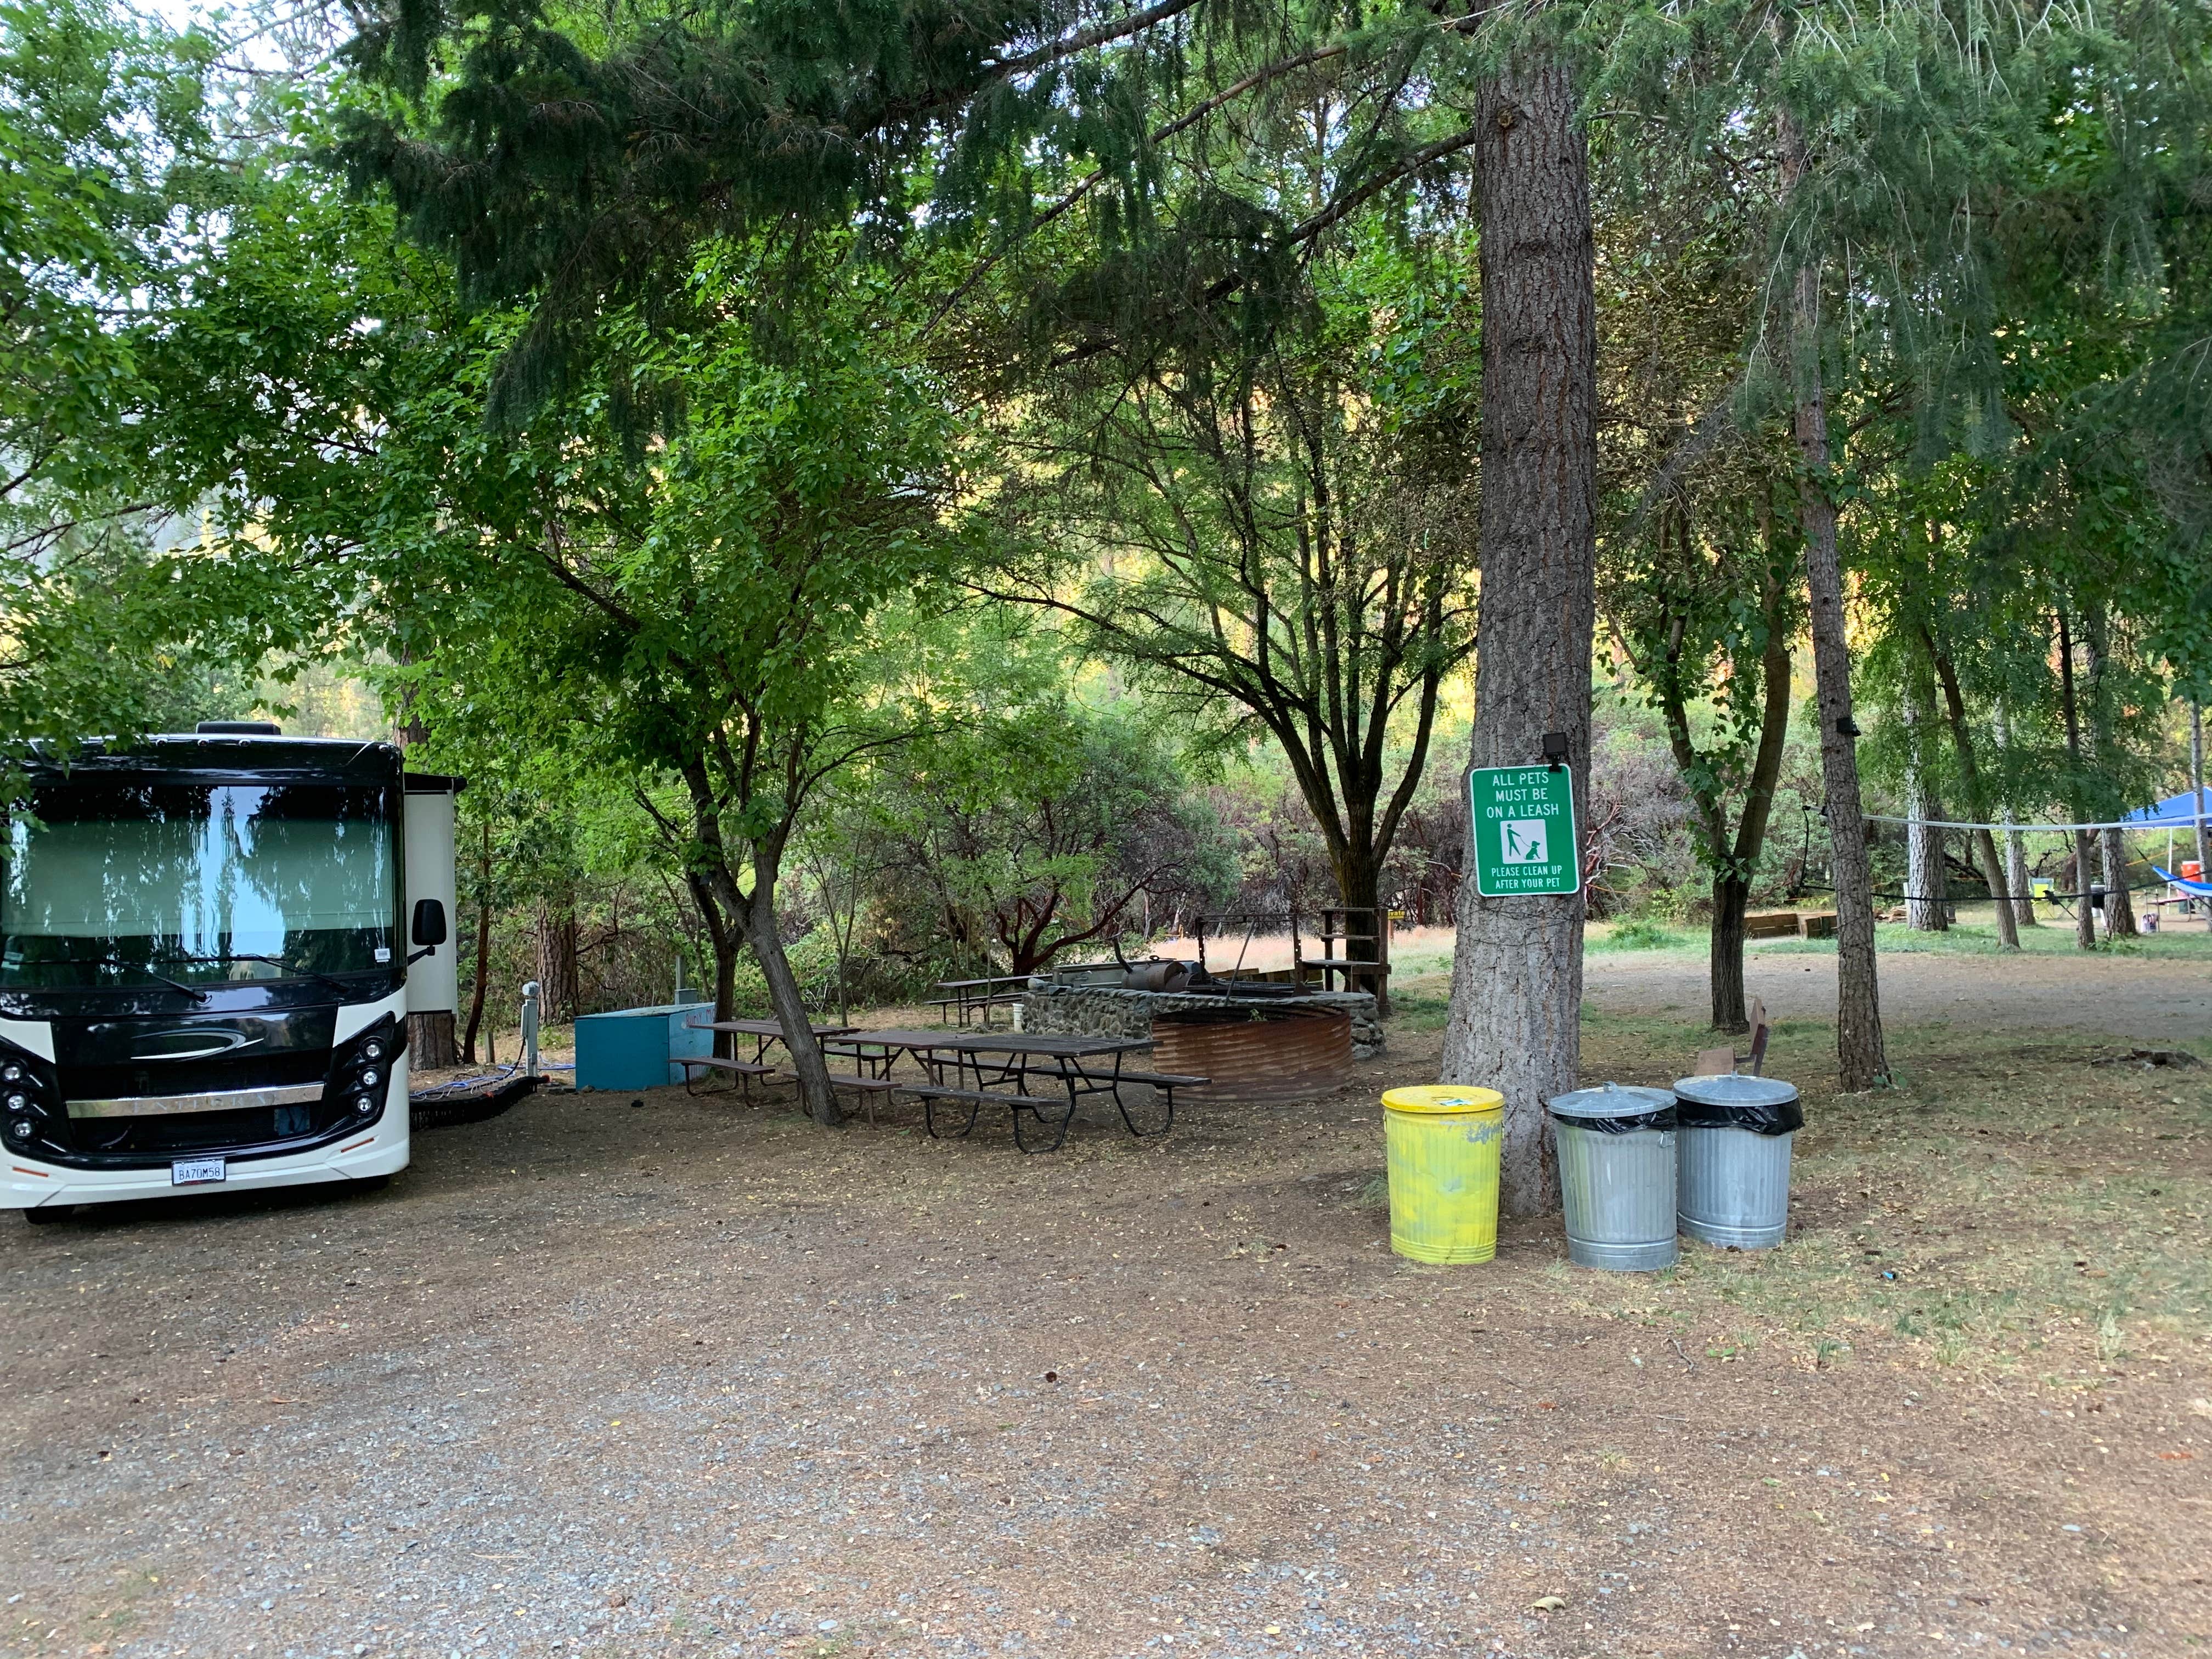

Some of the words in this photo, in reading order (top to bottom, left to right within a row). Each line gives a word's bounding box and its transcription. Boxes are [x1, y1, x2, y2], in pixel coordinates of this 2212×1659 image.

[1493, 774, 1515, 786] ALL
[1519, 772, 1549, 785] PETS
[1496, 789, 1527, 802] MUST
[1532, 788, 1548, 800] BE
[1487, 806, 1503, 819] ON
[1508, 806, 1516, 817] A
[1520, 803, 1559, 817] LEASH
[1491, 867, 1520, 877] PLEASE
[1523, 866, 1548, 876] CLEAN
[1551, 865, 1562, 874] UP
[1496, 879, 1519, 889] AFTER
[1521, 878, 1543, 888] YOUR
[1546, 877, 1560, 887] PET
